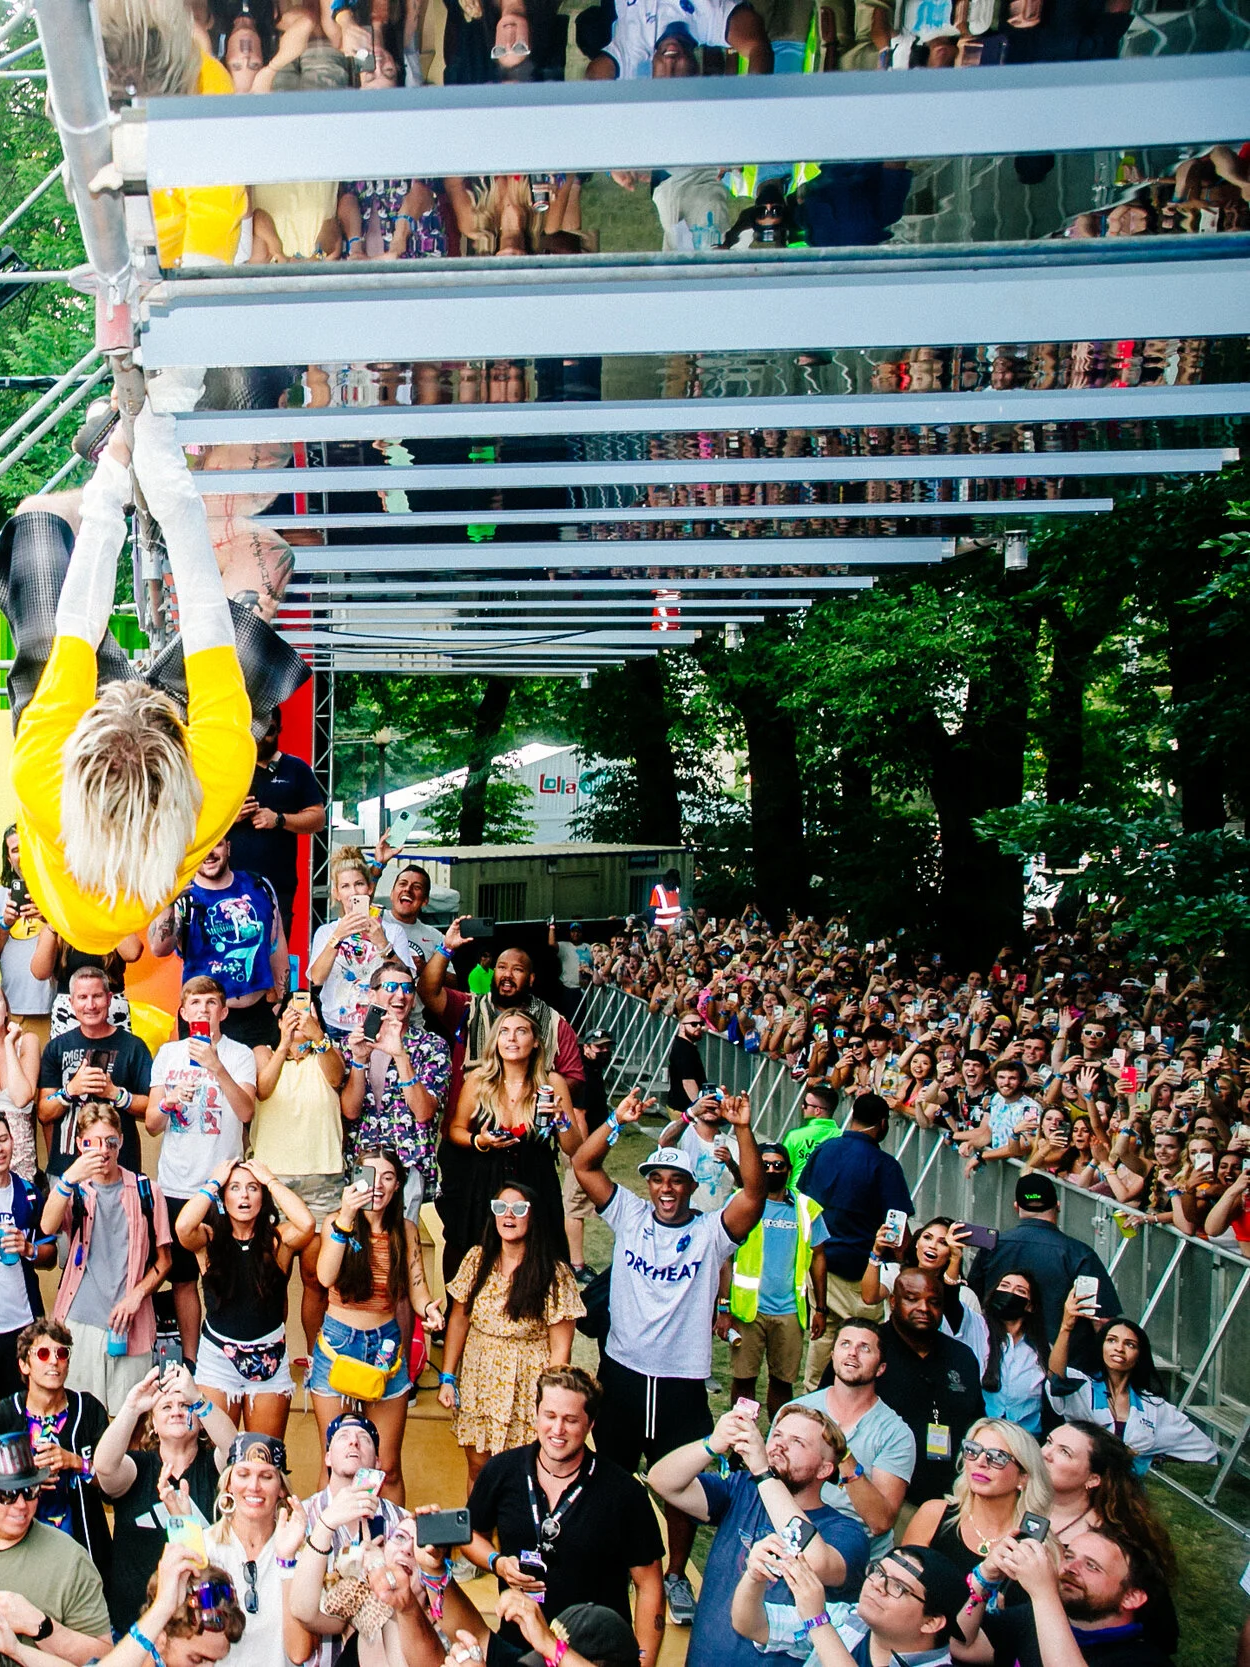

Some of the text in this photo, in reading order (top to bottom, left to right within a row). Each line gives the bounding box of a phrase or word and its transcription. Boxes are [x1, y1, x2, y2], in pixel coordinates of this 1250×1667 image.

[539, 773, 577, 795] Lolla
[62, 1049, 85, 1069] RAGE
[625, 1249, 702, 1281] DRYHEAT
